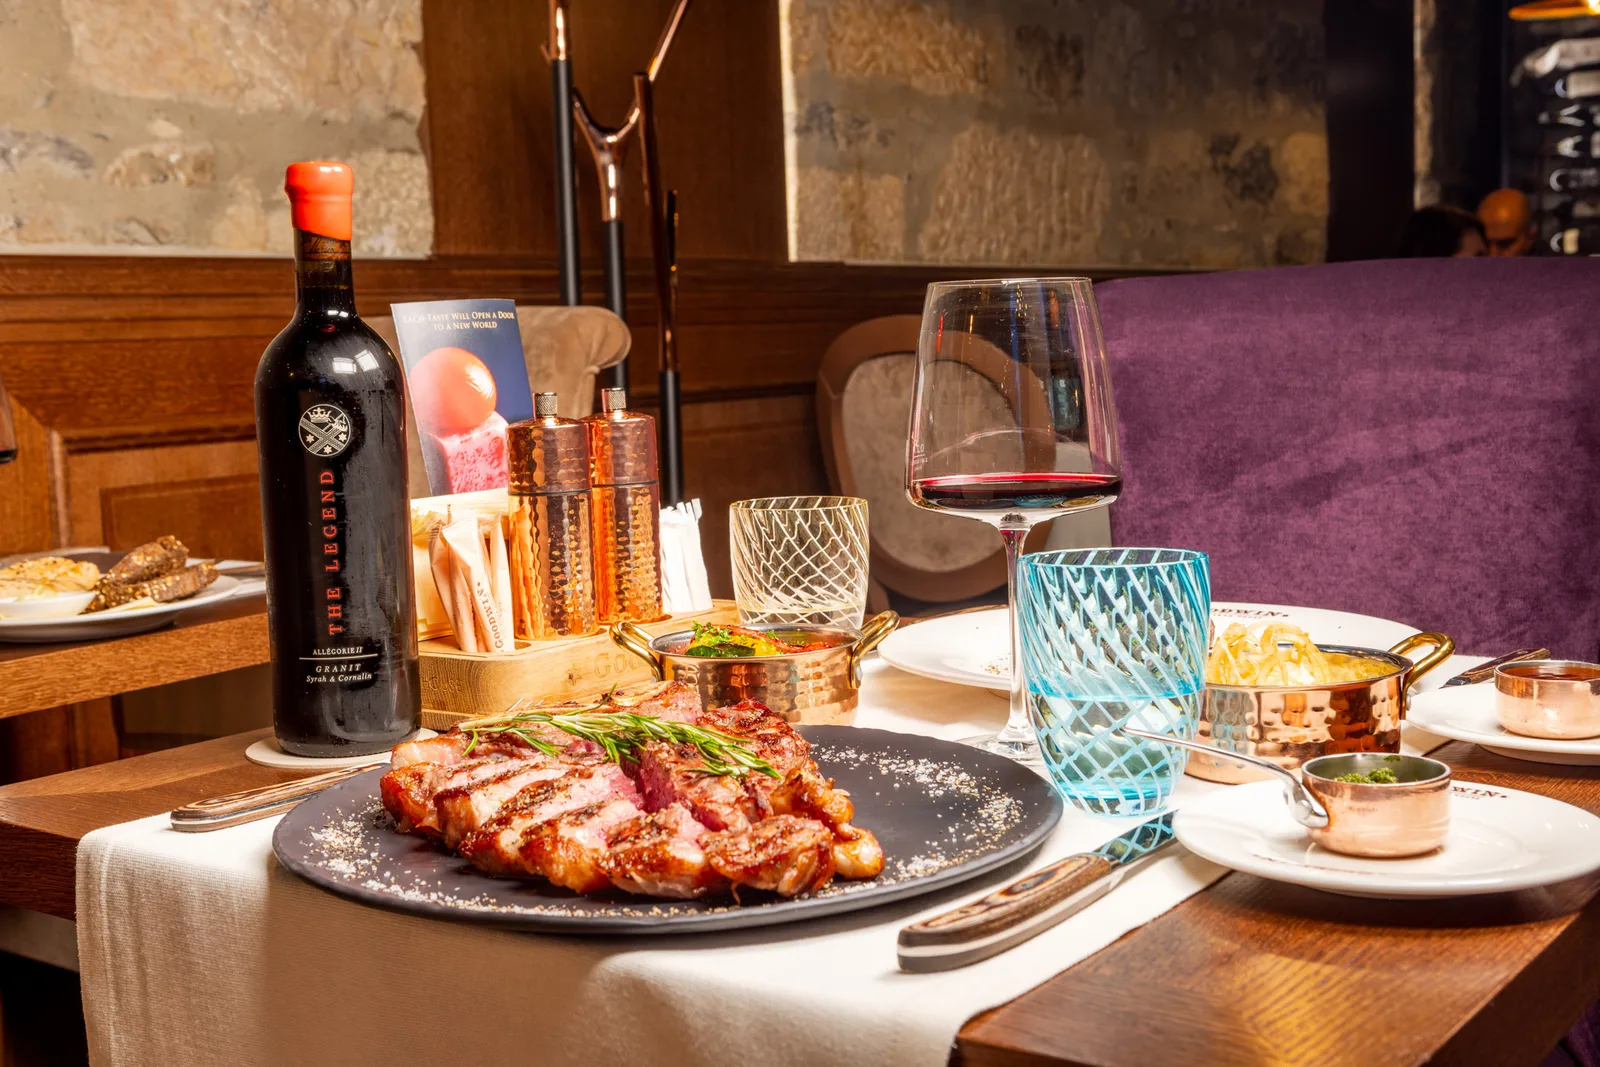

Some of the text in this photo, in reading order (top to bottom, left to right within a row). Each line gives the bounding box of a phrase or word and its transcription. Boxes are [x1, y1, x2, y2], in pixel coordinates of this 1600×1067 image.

[451, 312, 470, 320] WILL
[471, 311, 491, 320] OPEN
[498, 310, 515, 319] DOOR
[446, 323, 451, 331] A
[453, 322, 471, 330] NEW
[471, 321, 498, 329] WORLD
[320, 470, 343, 636] THE LEGEND
[315, 663, 362, 673] GRANIT
[306, 675, 327, 684] Syrah
[338, 672, 372, 682] Cornalin
